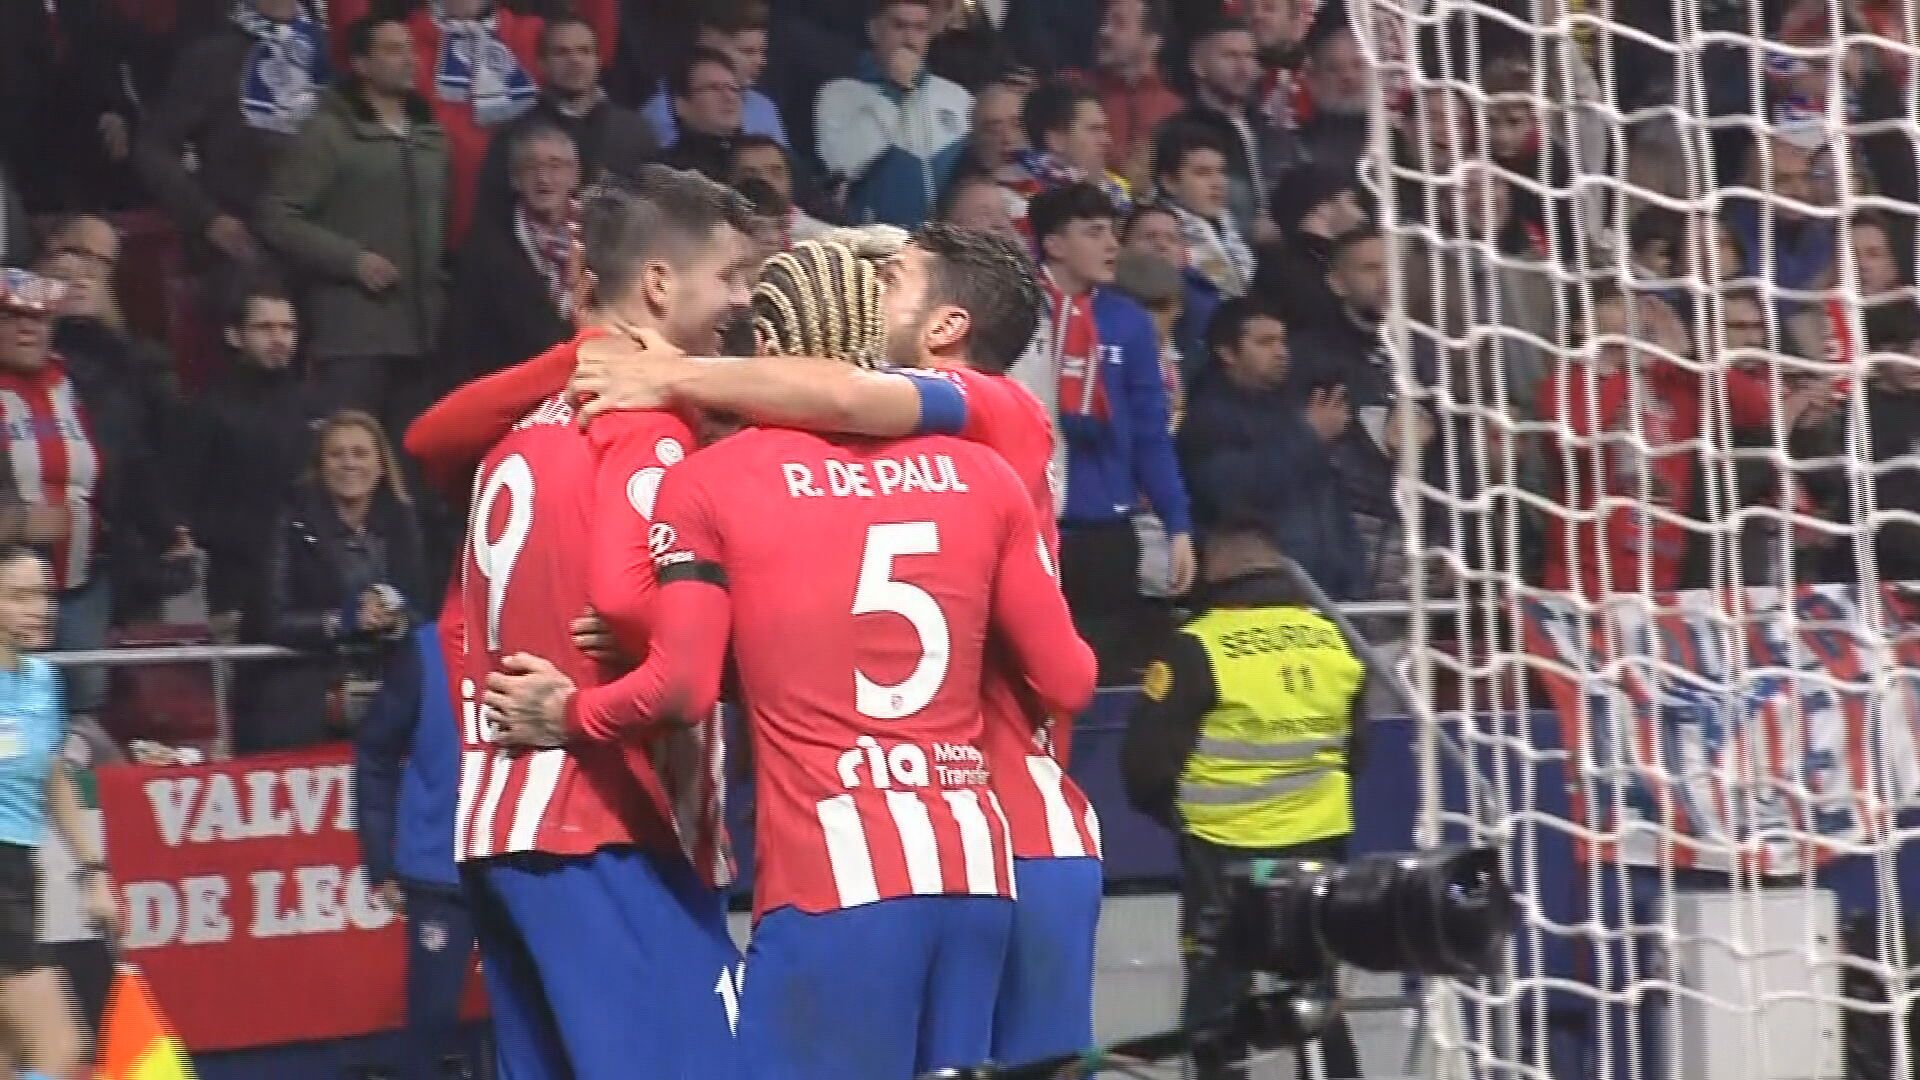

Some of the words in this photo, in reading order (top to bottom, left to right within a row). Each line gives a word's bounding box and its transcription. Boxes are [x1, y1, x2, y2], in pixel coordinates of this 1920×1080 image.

[825, 459, 875, 498] DE
[875, 454, 969, 495] PAUL
[850, 521, 951, 720] 5
[836, 735, 931, 789] ria
[120, 872, 230, 949] DE
